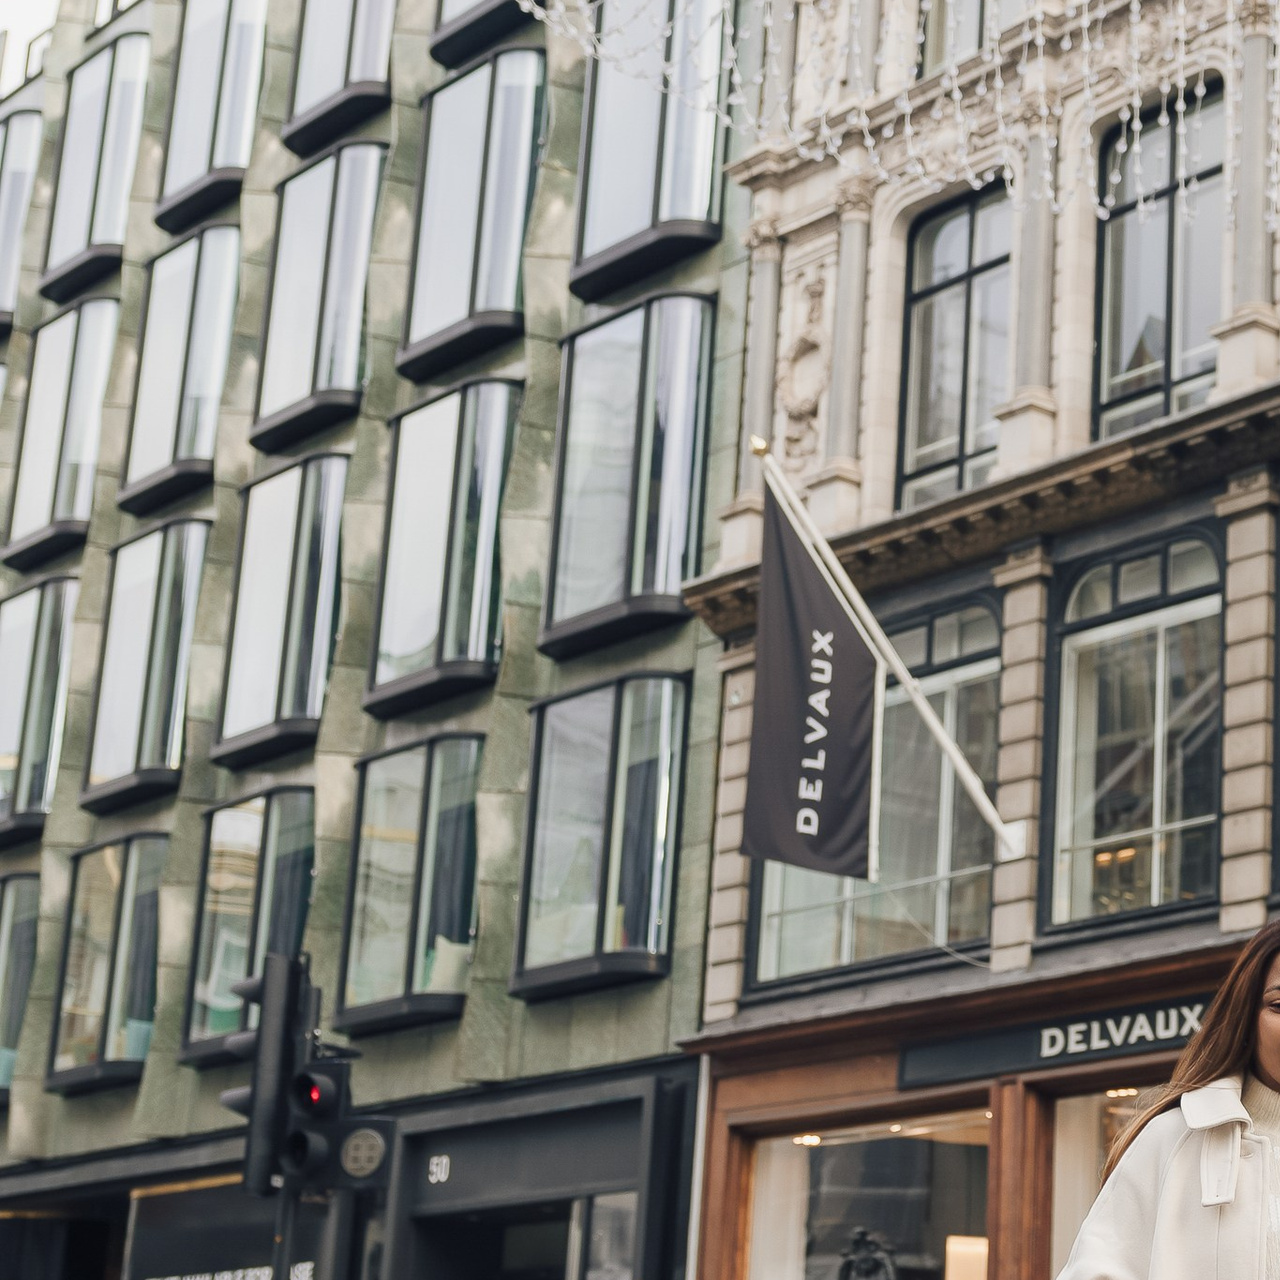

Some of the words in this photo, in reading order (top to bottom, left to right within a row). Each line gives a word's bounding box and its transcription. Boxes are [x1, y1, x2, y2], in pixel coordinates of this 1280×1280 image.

[796, 629, 834, 836] DELVAUX
[1040, 1004, 1203, 1058] DELVAUX
[428, 1155, 450, 1184] 50
